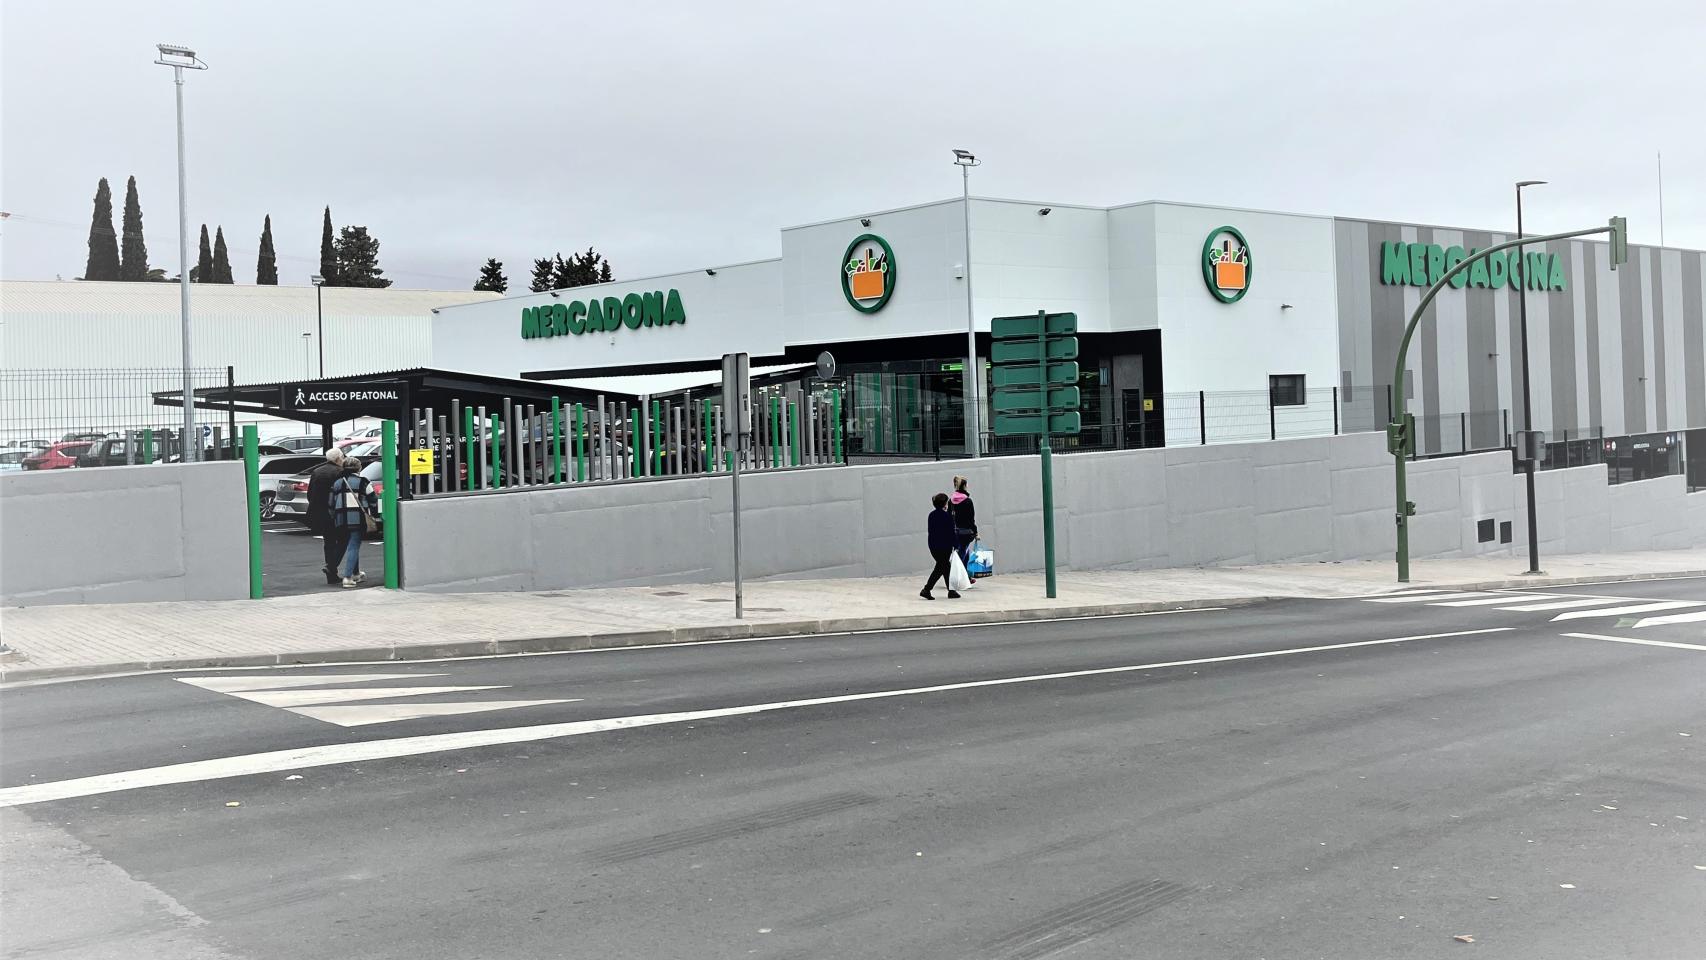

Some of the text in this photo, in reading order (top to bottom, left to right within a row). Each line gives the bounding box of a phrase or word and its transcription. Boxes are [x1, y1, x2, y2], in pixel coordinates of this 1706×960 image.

[1380, 240, 1567, 291] MERCADONA
[521, 288, 686, 339] MERCADONA
[309, 391, 398, 401] ACCESO PEATONAL
